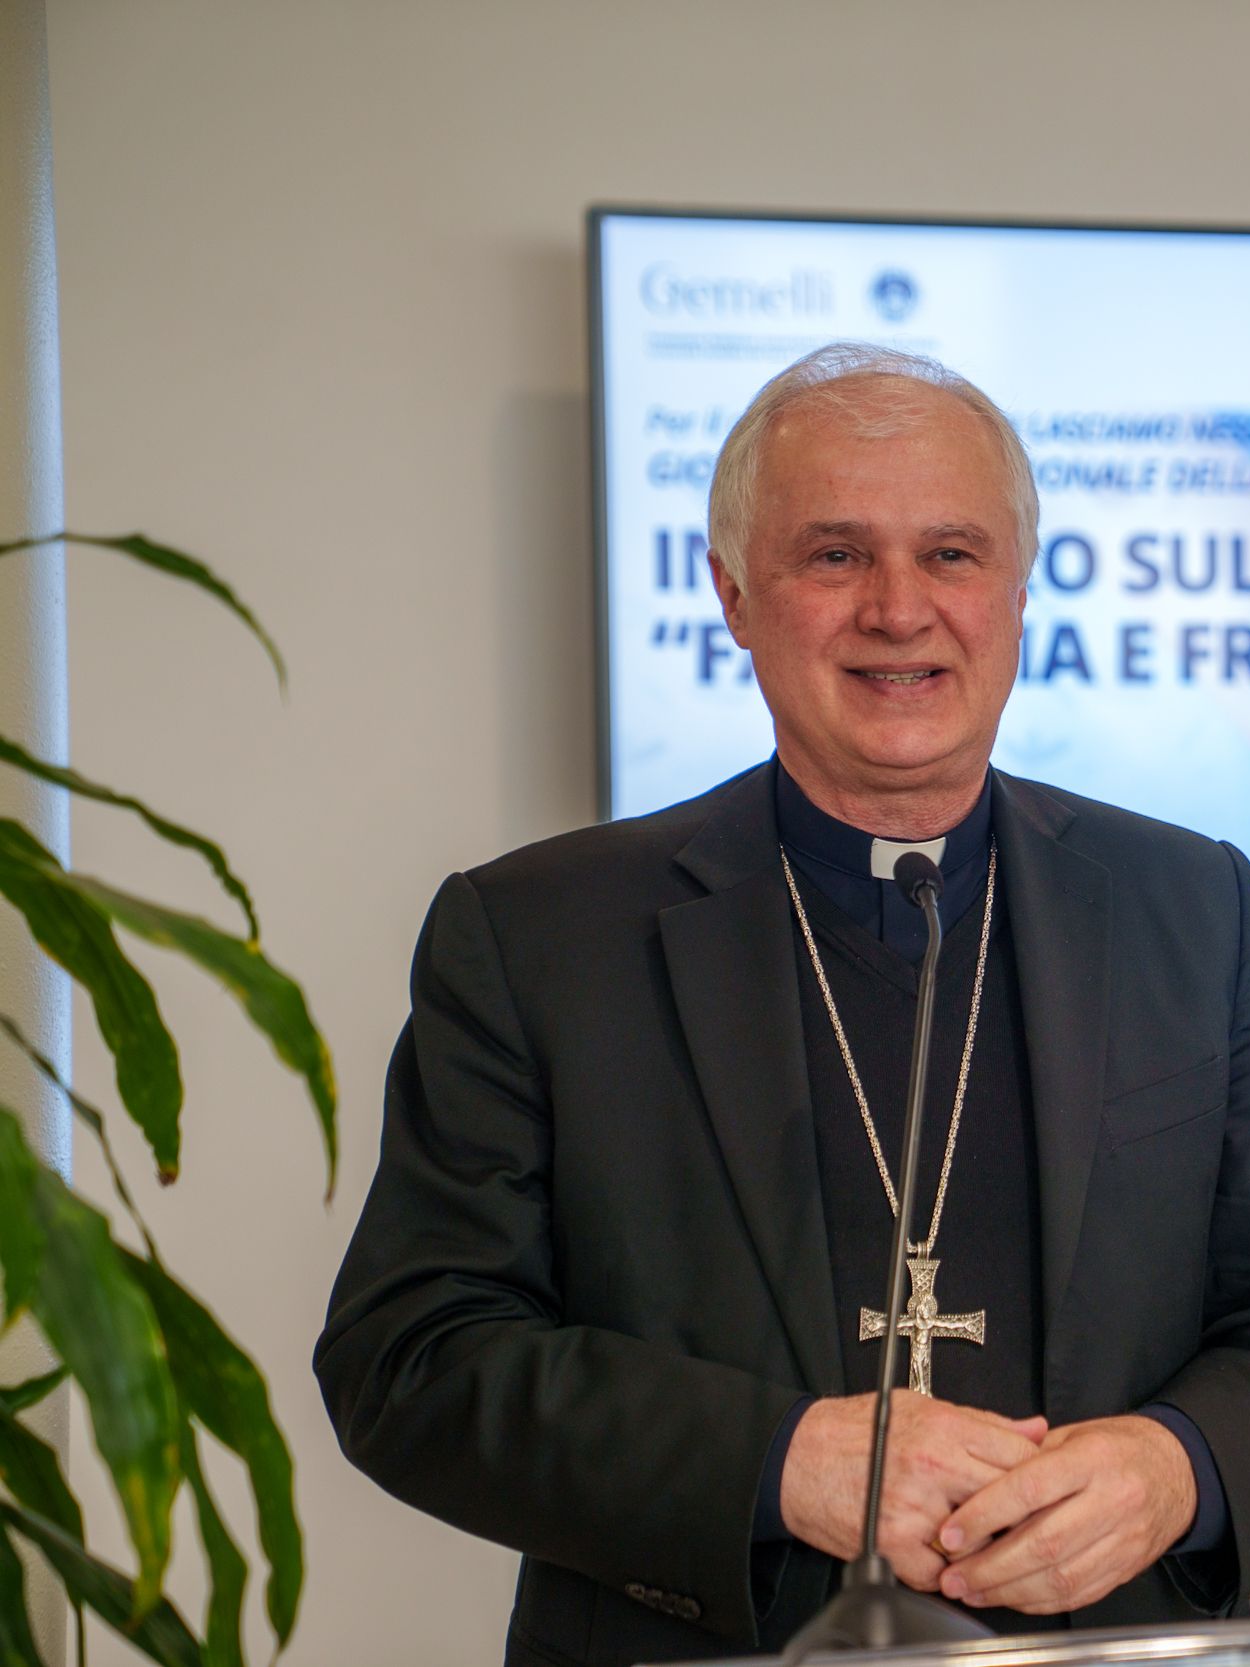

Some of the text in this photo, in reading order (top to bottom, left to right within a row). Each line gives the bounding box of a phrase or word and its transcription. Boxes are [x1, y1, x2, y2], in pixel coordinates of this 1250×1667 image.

[642, 260, 834, 317] Gemelli
[645, 405, 696, 437] Per
[1031, 412, 1176, 442] LASCIAMO
[1119, 625, 1151, 682] E
